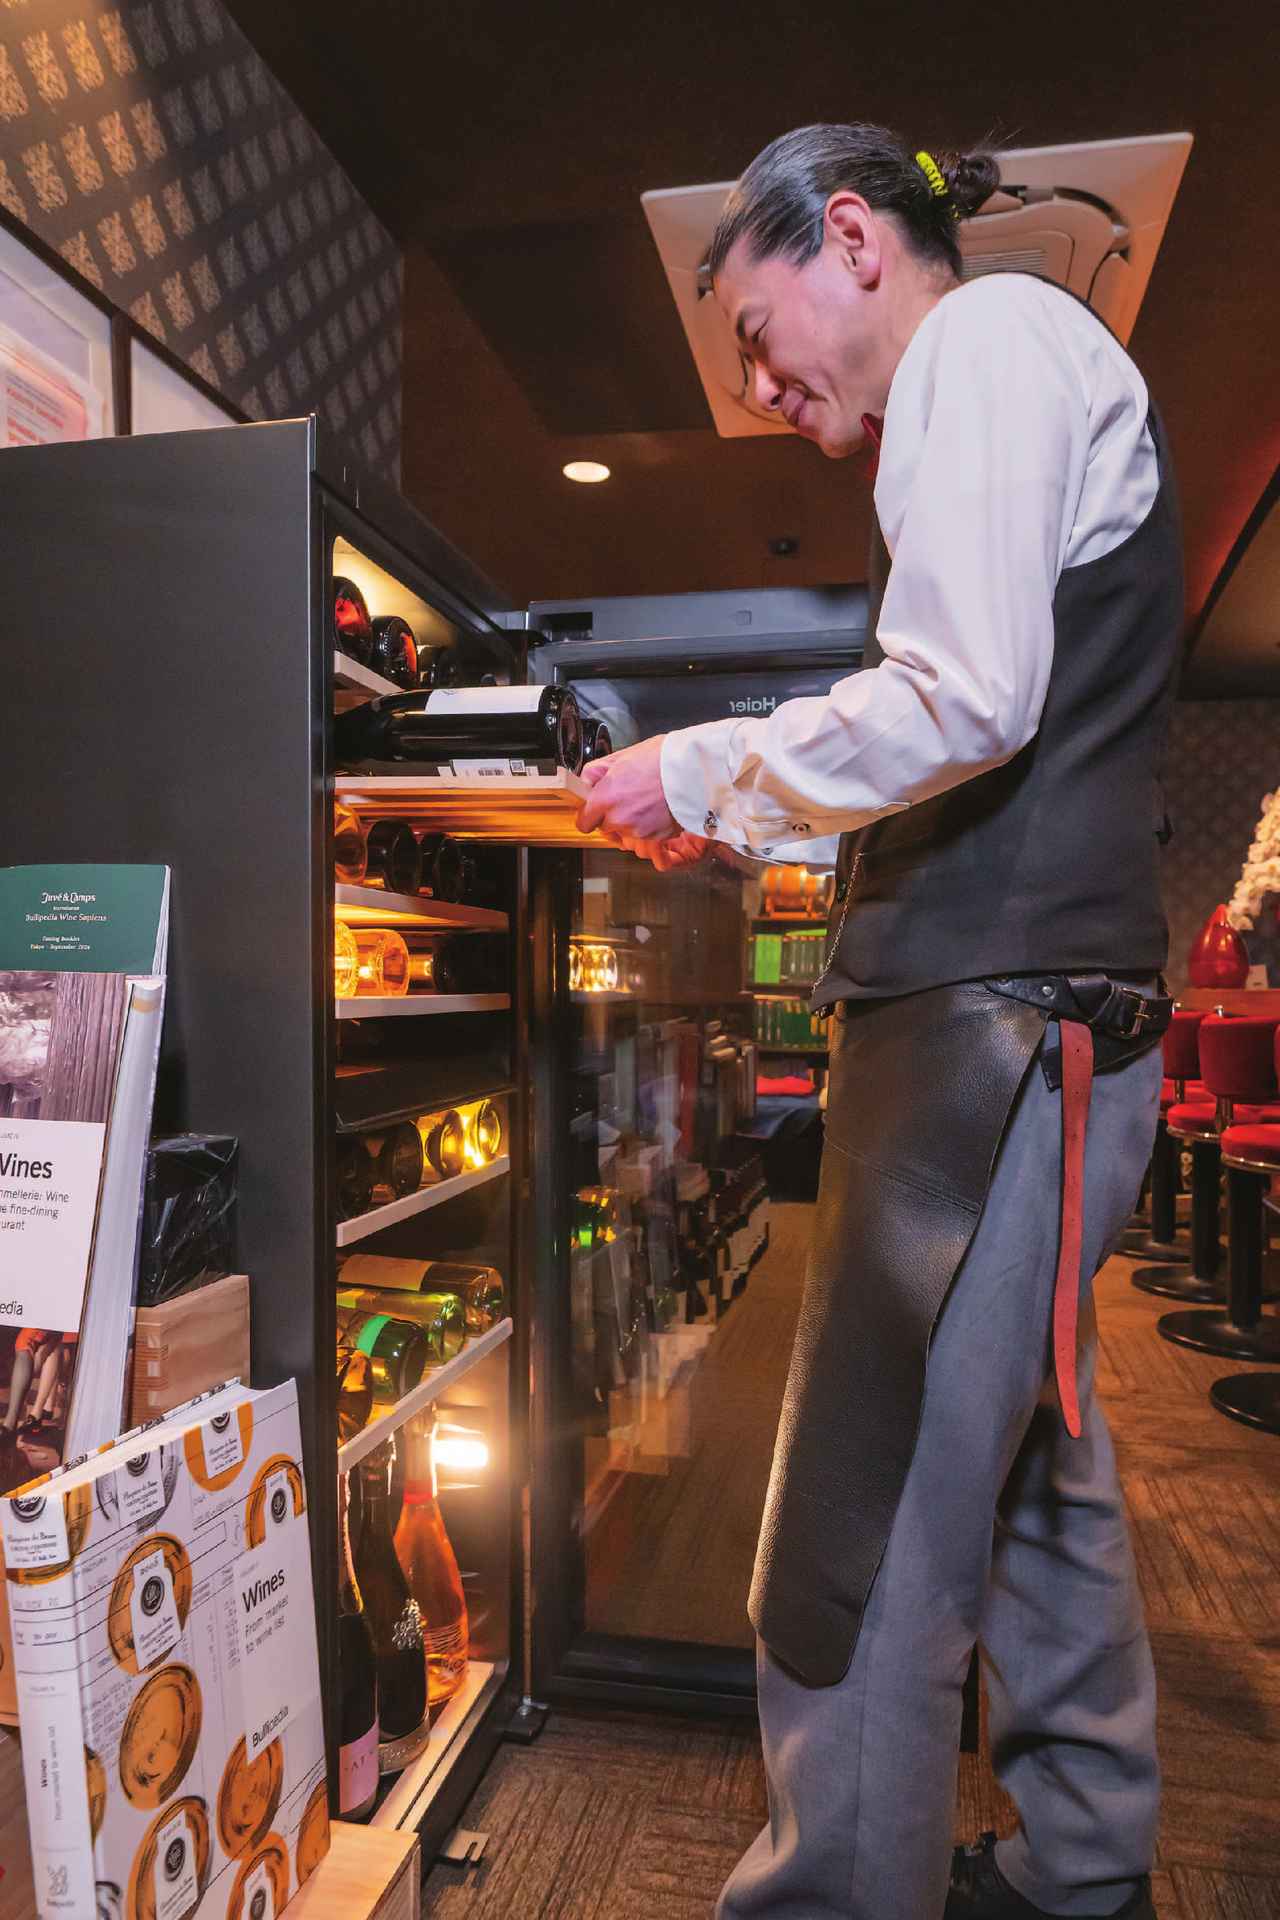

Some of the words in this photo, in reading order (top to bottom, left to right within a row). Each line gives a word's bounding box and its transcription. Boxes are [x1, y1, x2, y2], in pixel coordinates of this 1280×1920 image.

[45, 1191, 70, 1203] Wine
[10, 1203, 60, 1220] fine-dining
[242, 1569, 285, 1613] Wines
